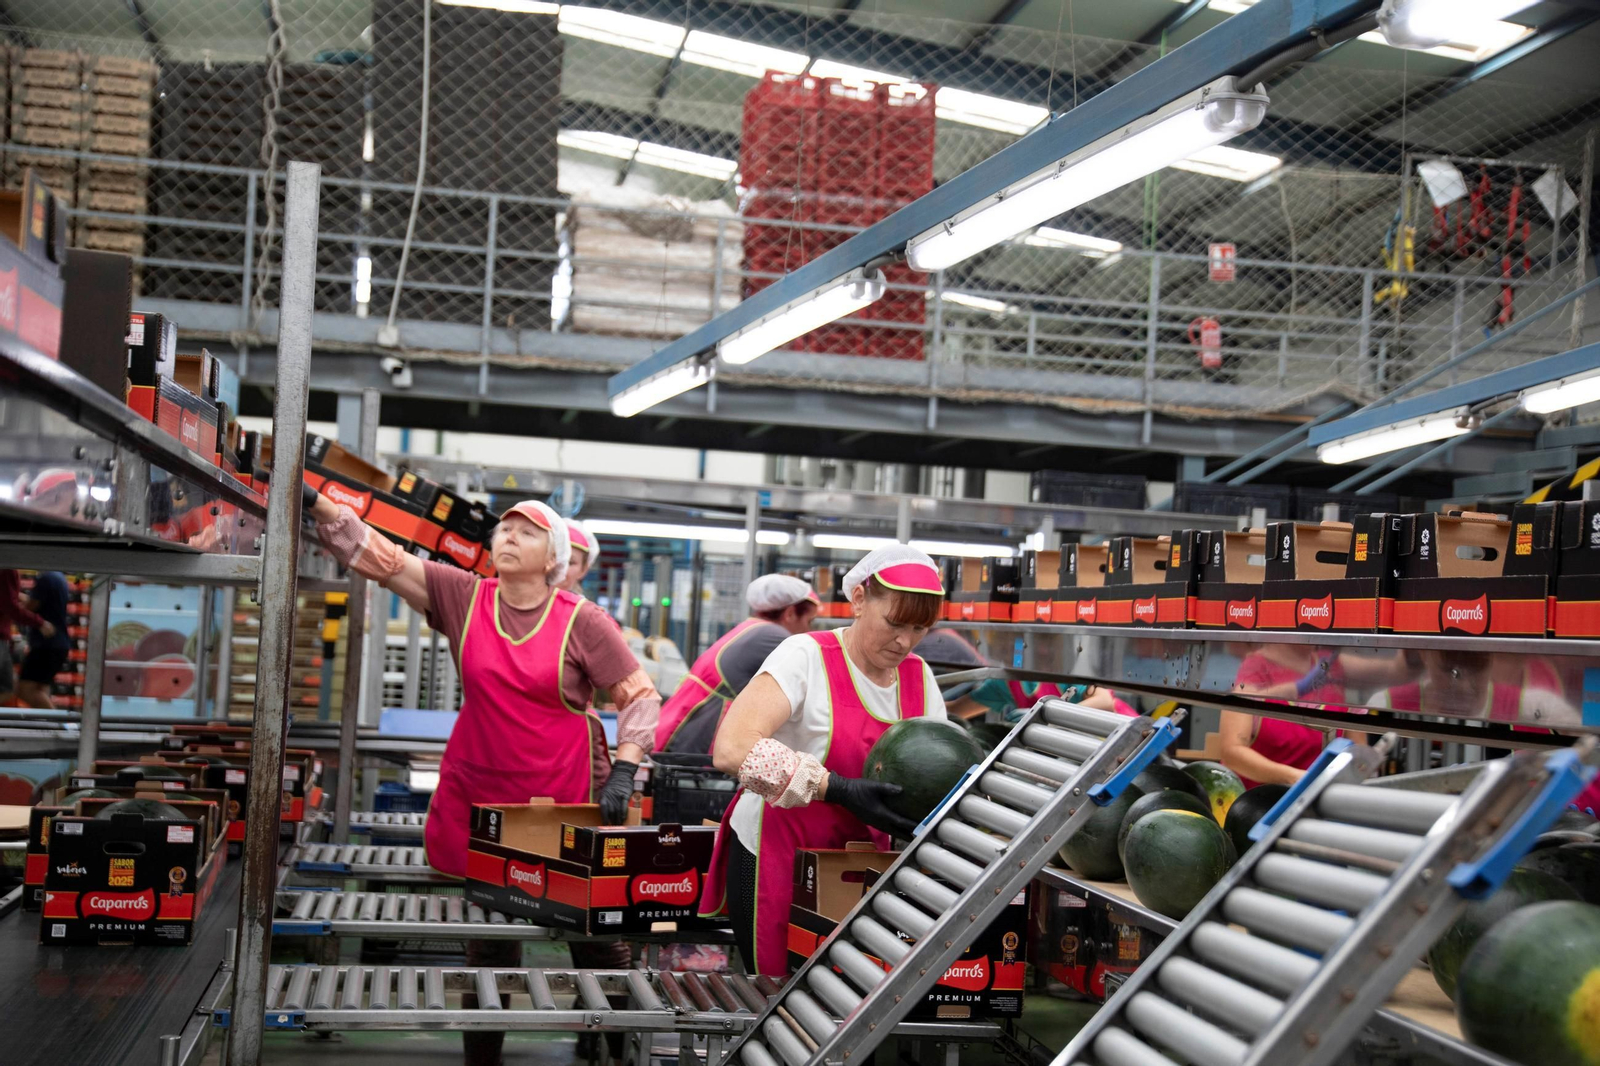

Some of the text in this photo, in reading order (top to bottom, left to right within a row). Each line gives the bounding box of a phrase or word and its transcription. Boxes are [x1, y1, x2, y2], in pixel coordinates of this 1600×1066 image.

[1515, 543, 1532, 555] 2025
[1355, 551, 1367, 561] 2025
[1229, 605, 1253, 619] Caparrós
[1301, 603, 1329, 620] Caparrós
[1447, 604, 1483, 623] Caparrós
[608, 838, 626, 846] SABOR
[114, 858, 134, 866] SABOR
[603, 857, 626, 867] 2025
[108, 876, 134, 886] 2025
[510, 865, 542, 885] Caparrós
[639, 877, 692, 897] Caparrós
[90, 896, 148, 911] Caparrós
[509, 895, 540, 909] PREMIUM
[639, 910, 690, 918] PREMIUM
[943, 963, 984, 980] parrós
[928, 994, 981, 1002] PREMIUM
